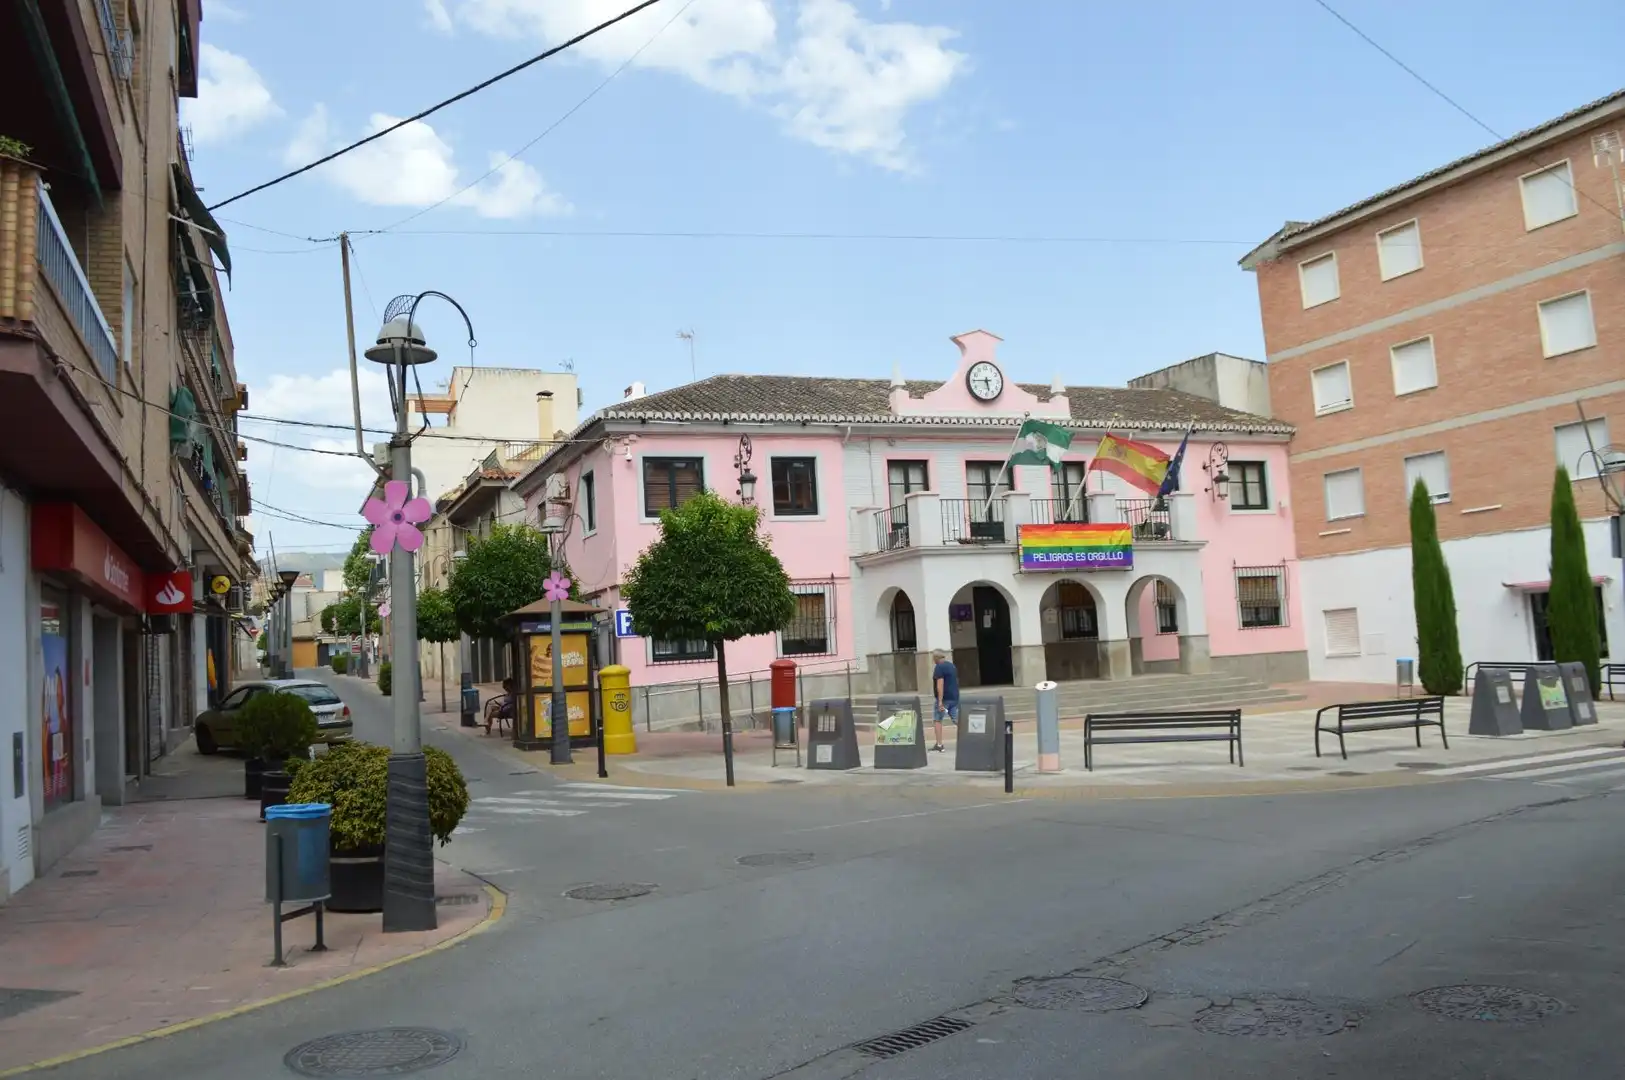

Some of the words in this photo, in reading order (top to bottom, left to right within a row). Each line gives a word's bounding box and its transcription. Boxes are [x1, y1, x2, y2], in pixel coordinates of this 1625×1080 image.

[1033, 552, 1074, 562] PELIGROS
[1075, 552, 1086, 561] ES
[1087, 551, 1124, 561] ORGULLO
